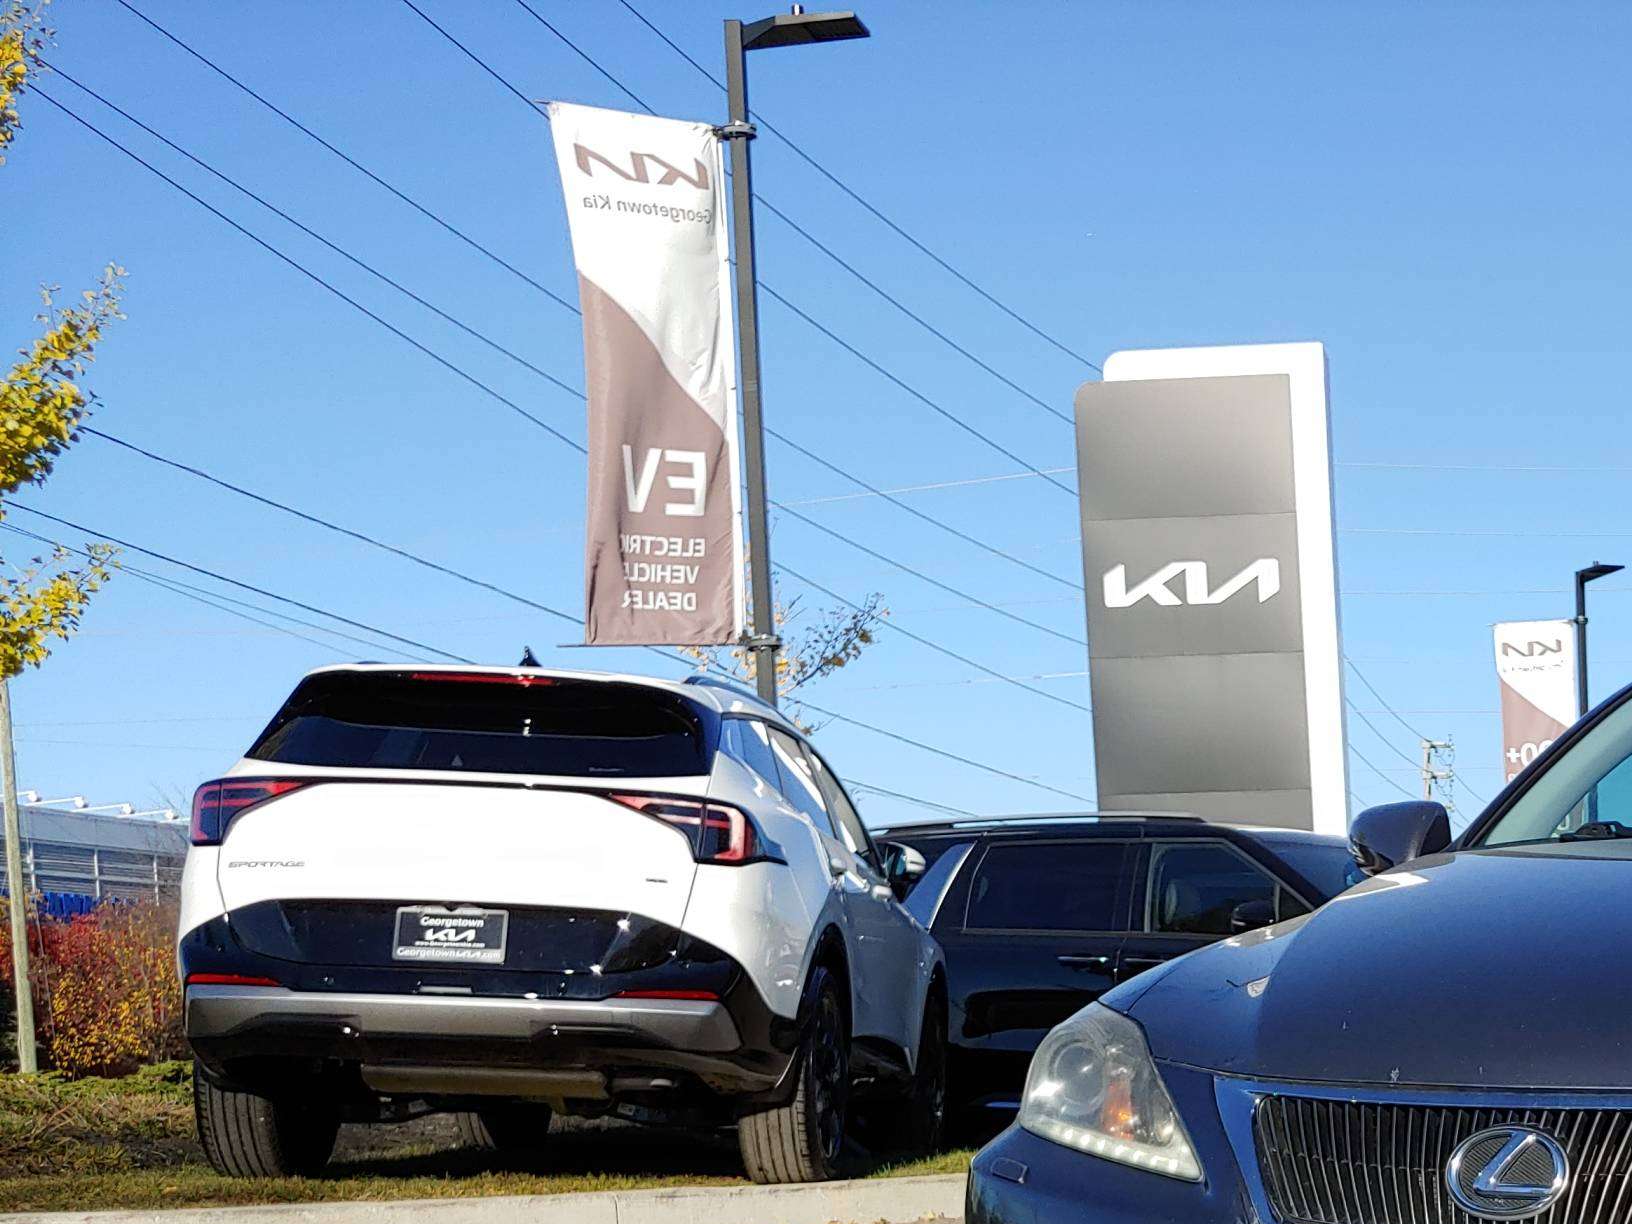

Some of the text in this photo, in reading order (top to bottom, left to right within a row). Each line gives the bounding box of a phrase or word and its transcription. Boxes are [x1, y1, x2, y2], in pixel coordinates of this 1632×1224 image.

[1103, 558, 1280, 608] KIA
[420, 916, 484, 928] Georgetown
[425, 928, 477, 941] KIA
